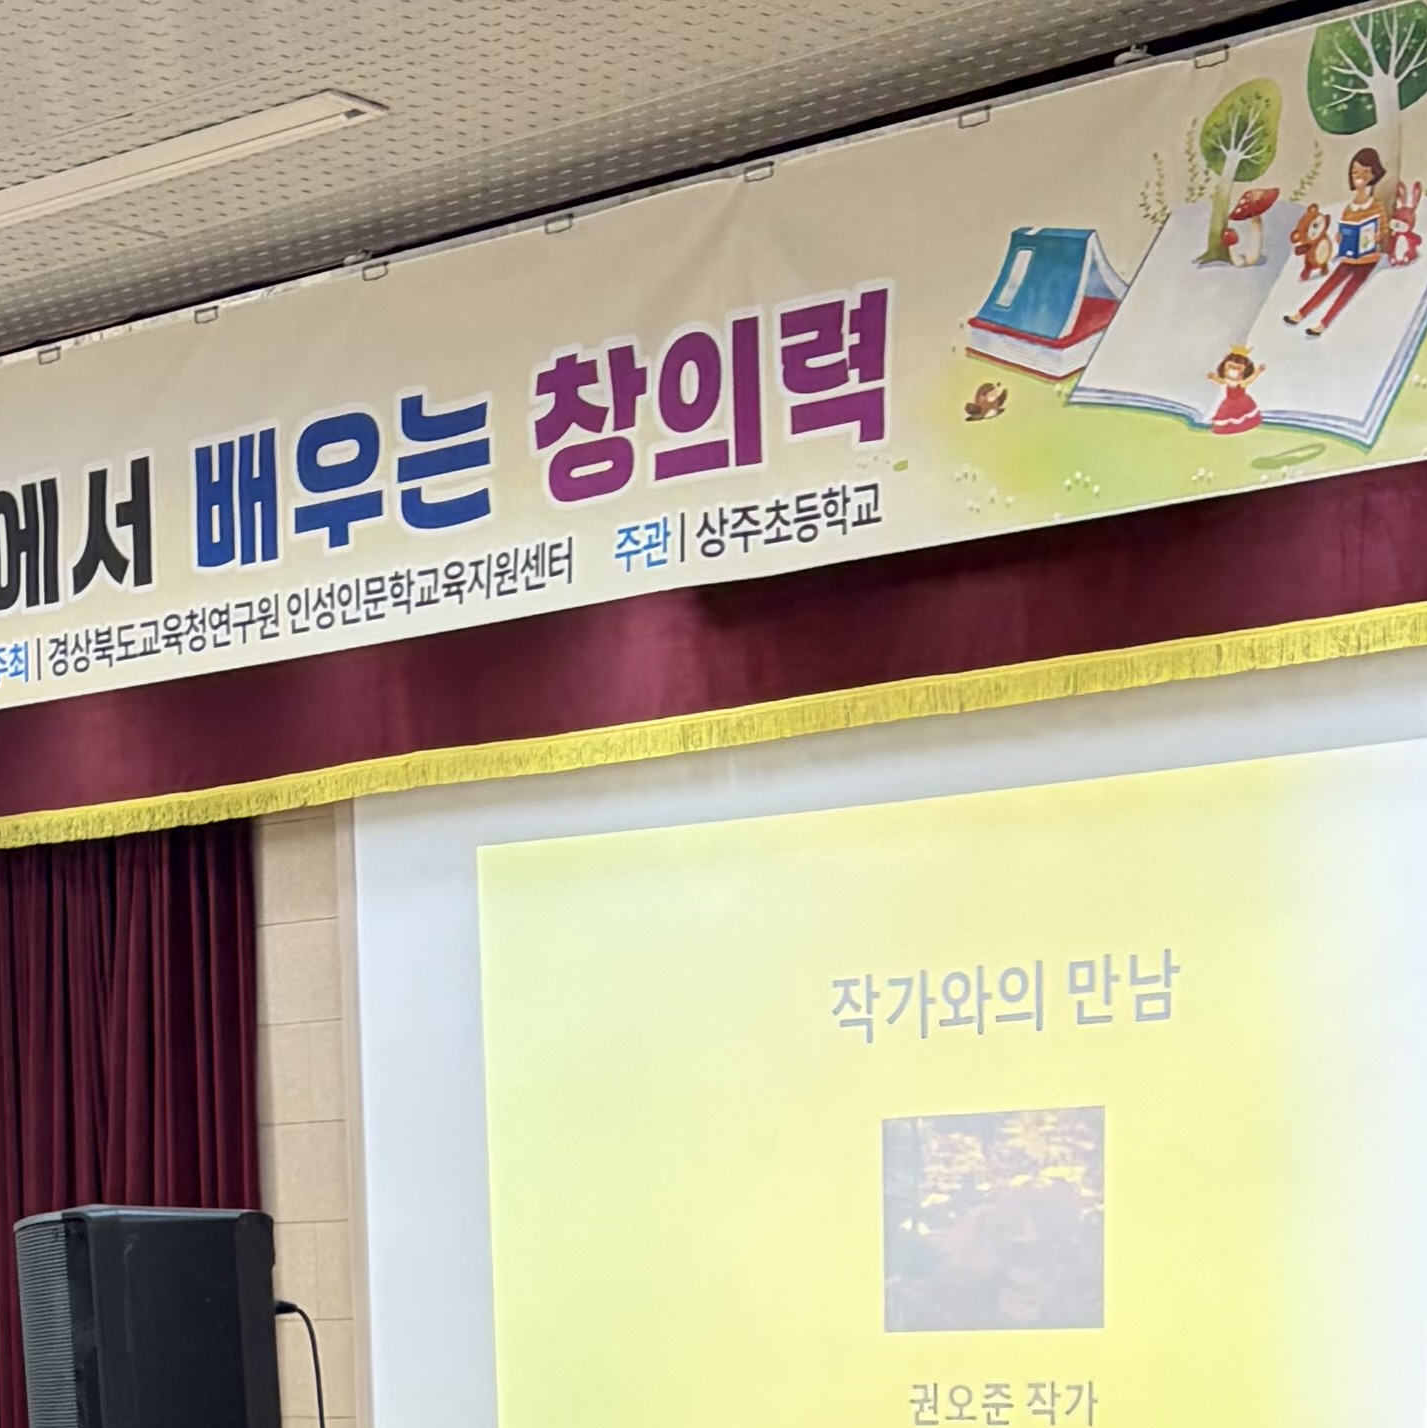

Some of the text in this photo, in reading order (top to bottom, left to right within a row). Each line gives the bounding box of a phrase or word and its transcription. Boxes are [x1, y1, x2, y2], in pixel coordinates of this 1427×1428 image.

[194, 394, 492, 570] 배우는
[533, 285, 890, 503] 창의력
[47, 596, 281, 677] 경상북도교육청연구원
[286, 536, 574, 631] 인성인문학교육지원센터
[614, 516, 672, 573] 주관
[696, 483, 883, 559] 상주초등학교
[831, 948, 1181, 1043] 작가와의 만남
[909, 1380, 1099, 1427] 권오준 작가
